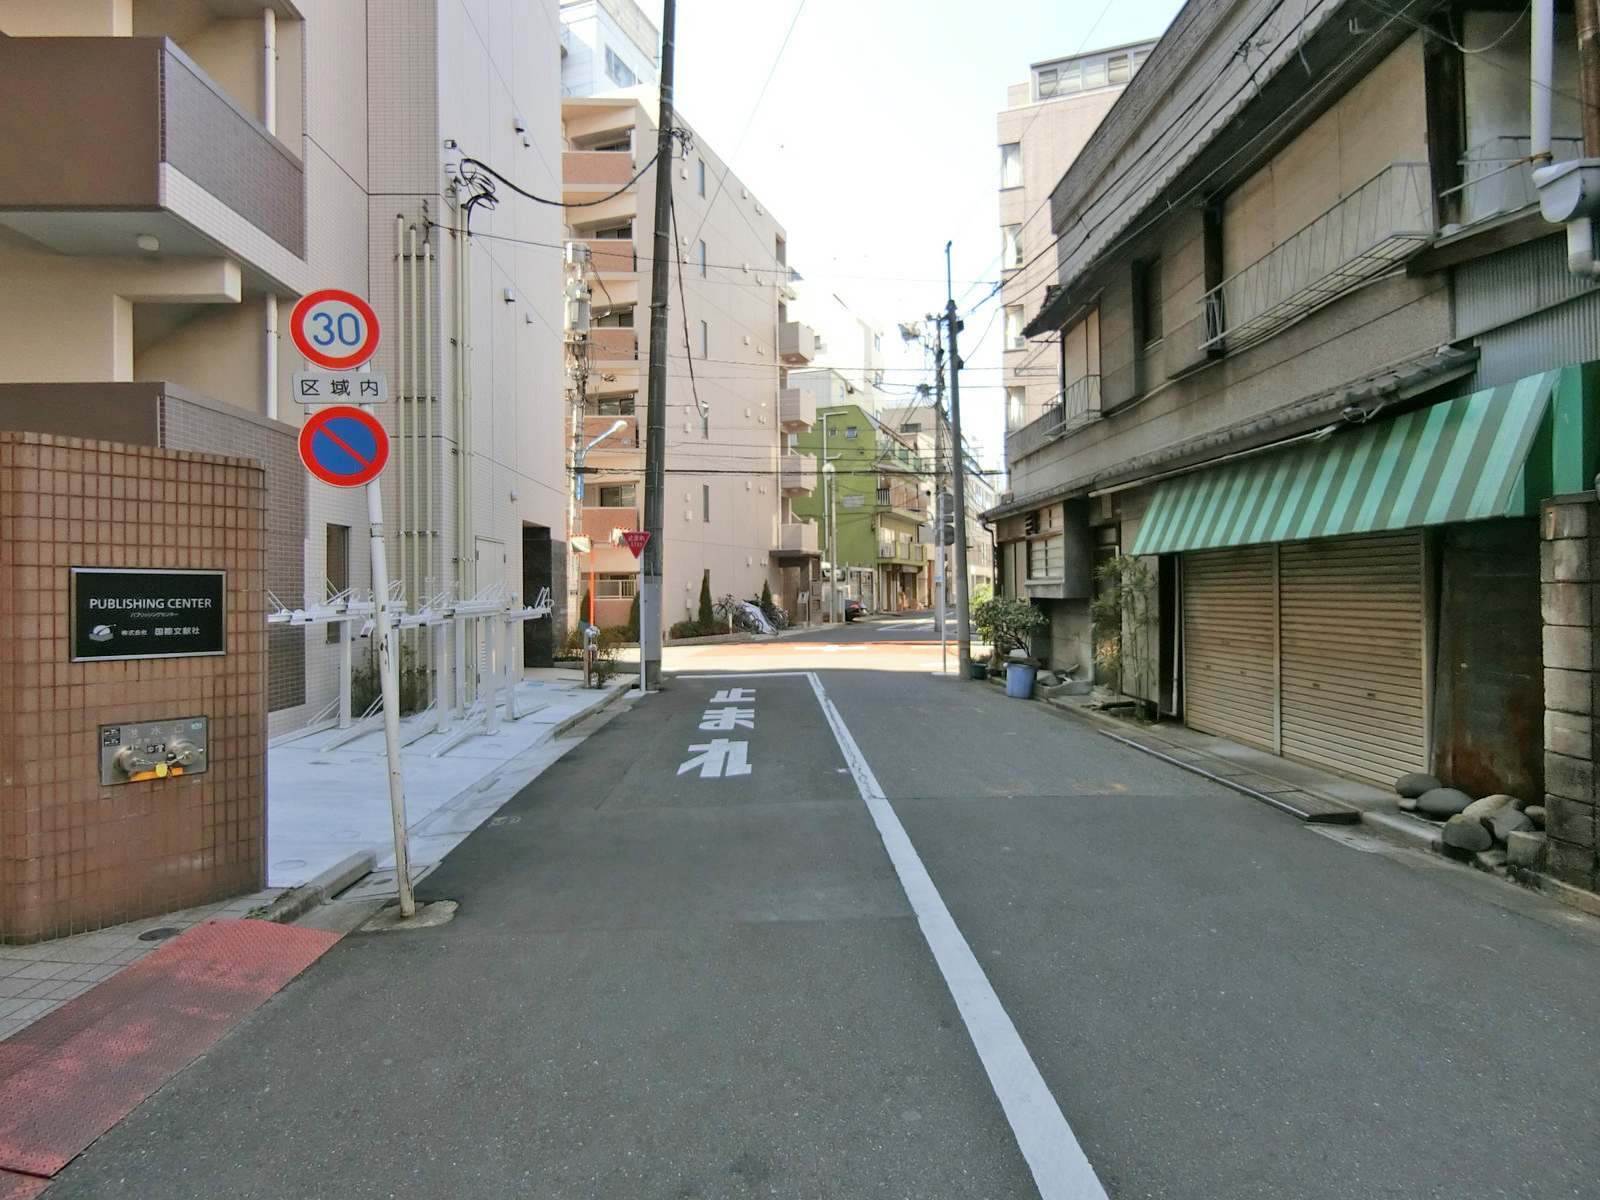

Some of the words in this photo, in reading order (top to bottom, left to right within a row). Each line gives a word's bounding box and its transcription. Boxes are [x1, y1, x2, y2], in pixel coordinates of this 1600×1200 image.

[312, 312, 361, 347] 30
[301, 378, 379, 397] 区域内
[89, 598, 165, 609] PUBLISHING
[167, 598, 212, 609] CENTER
[154, 626, 201, 636] 国際文献社
[677, 687, 756, 777] 止まれ
